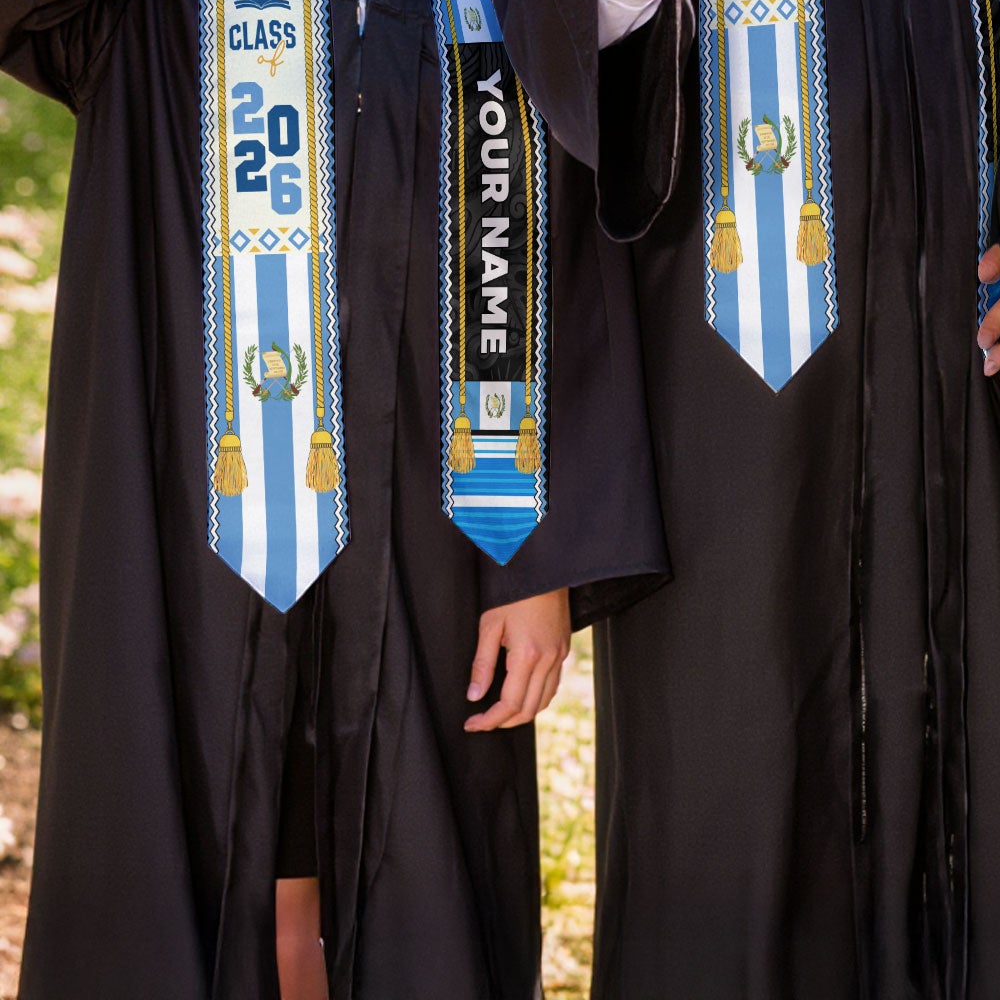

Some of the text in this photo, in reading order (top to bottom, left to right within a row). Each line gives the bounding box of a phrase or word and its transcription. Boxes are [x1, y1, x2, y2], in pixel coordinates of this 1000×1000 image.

[229, 19, 297, 50] CLASS
[257, 39, 286, 77] of
[477, 68, 511, 355] YOUR NAME
